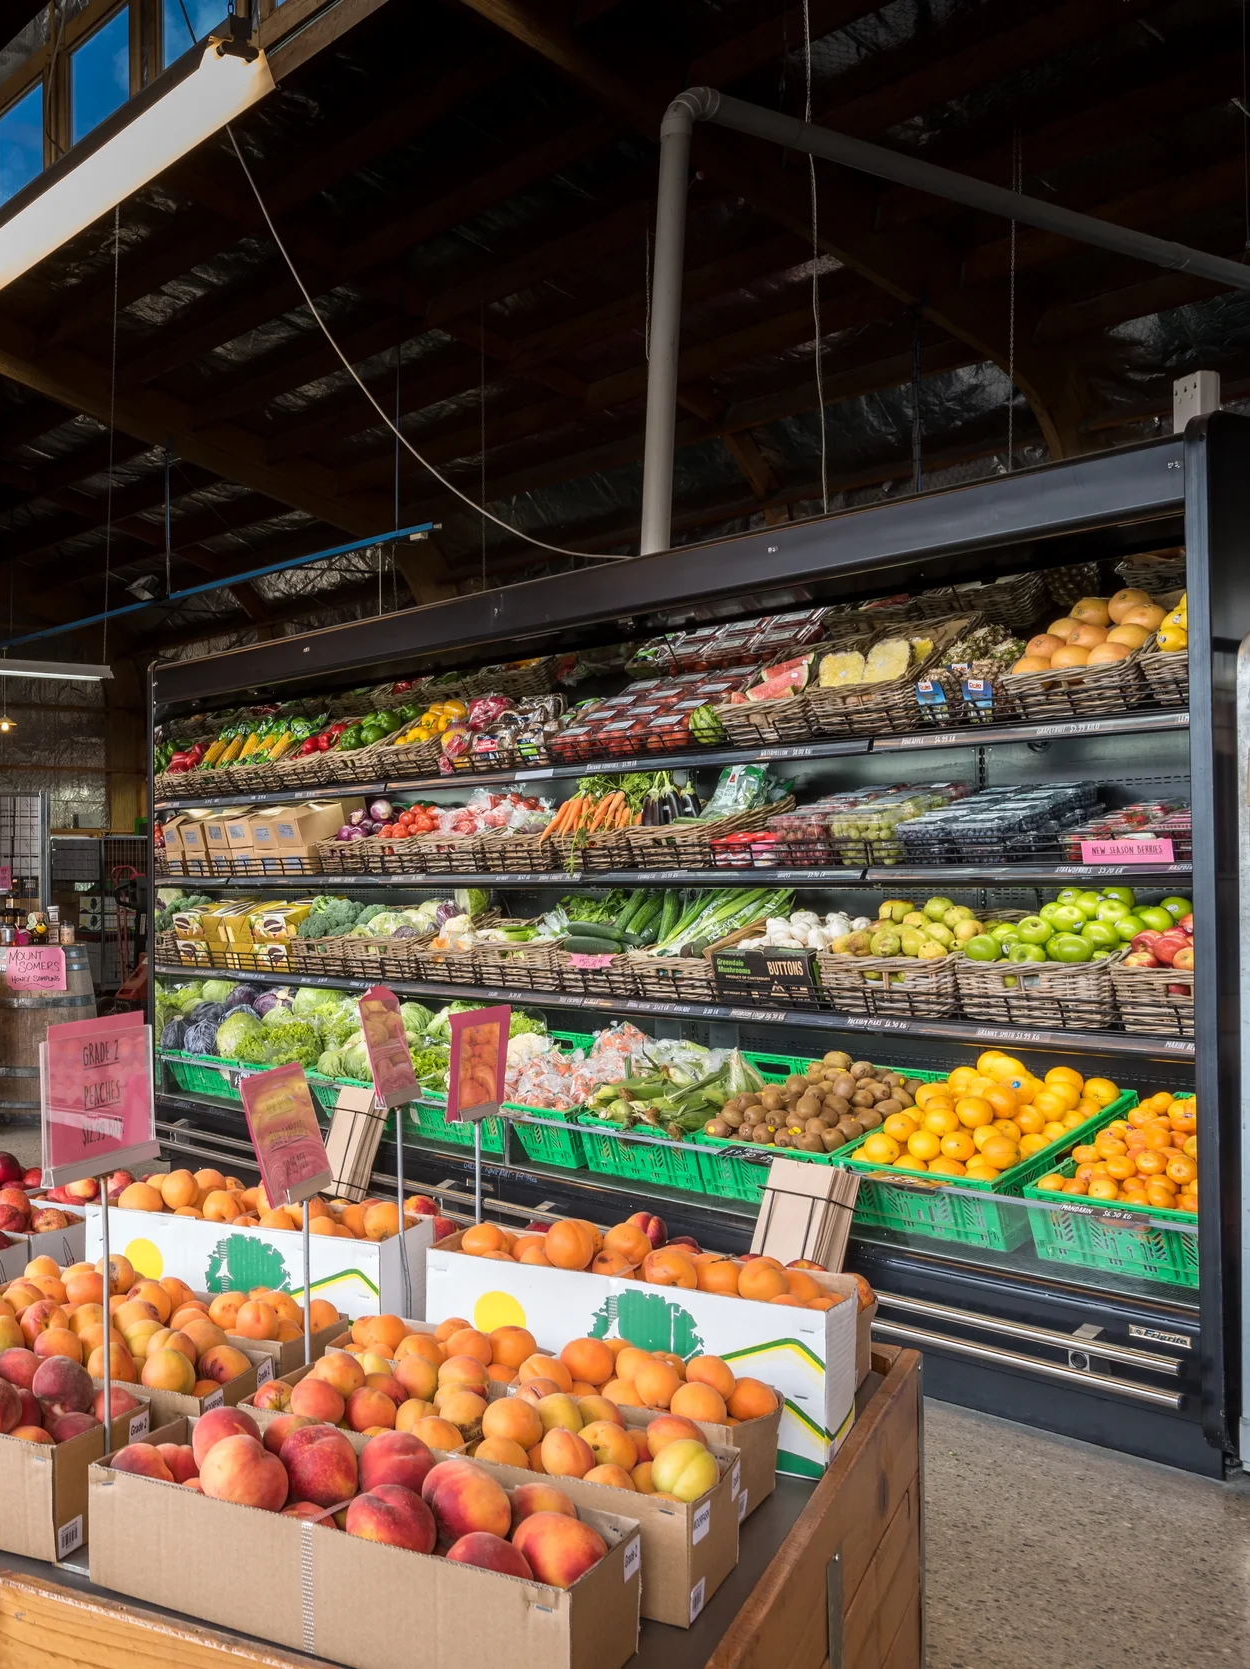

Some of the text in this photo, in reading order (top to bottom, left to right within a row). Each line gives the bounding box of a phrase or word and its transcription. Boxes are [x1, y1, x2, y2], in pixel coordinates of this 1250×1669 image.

[1036, 726, 1066, 734] GRAPEFRUIT
[1087, 723, 1100, 731] KILO
[1092, 844, 1163, 854] NEW SEASON BERRIES
[8, 949, 44, 966] MOUNT
[717, 958, 744, 967] Greendale
[18, 961, 60, 973] SOMERS
[766, 961, 803, 976] BUTTONS
[978, 1028, 998, 1036] GRANNY
[83, 1039, 119, 1066] GRADE 2
[84, 1080, 121, 1108] PEACHES
[82, 1122, 106, 1147] $12.99
[1144, 1330, 1187, 1345] Frigrite
[258, 1366, 270, 1383] Grade 2
[130, 1418, 147, 1436] Grade 2
[625, 1544, 638, 1568] Grade 2
